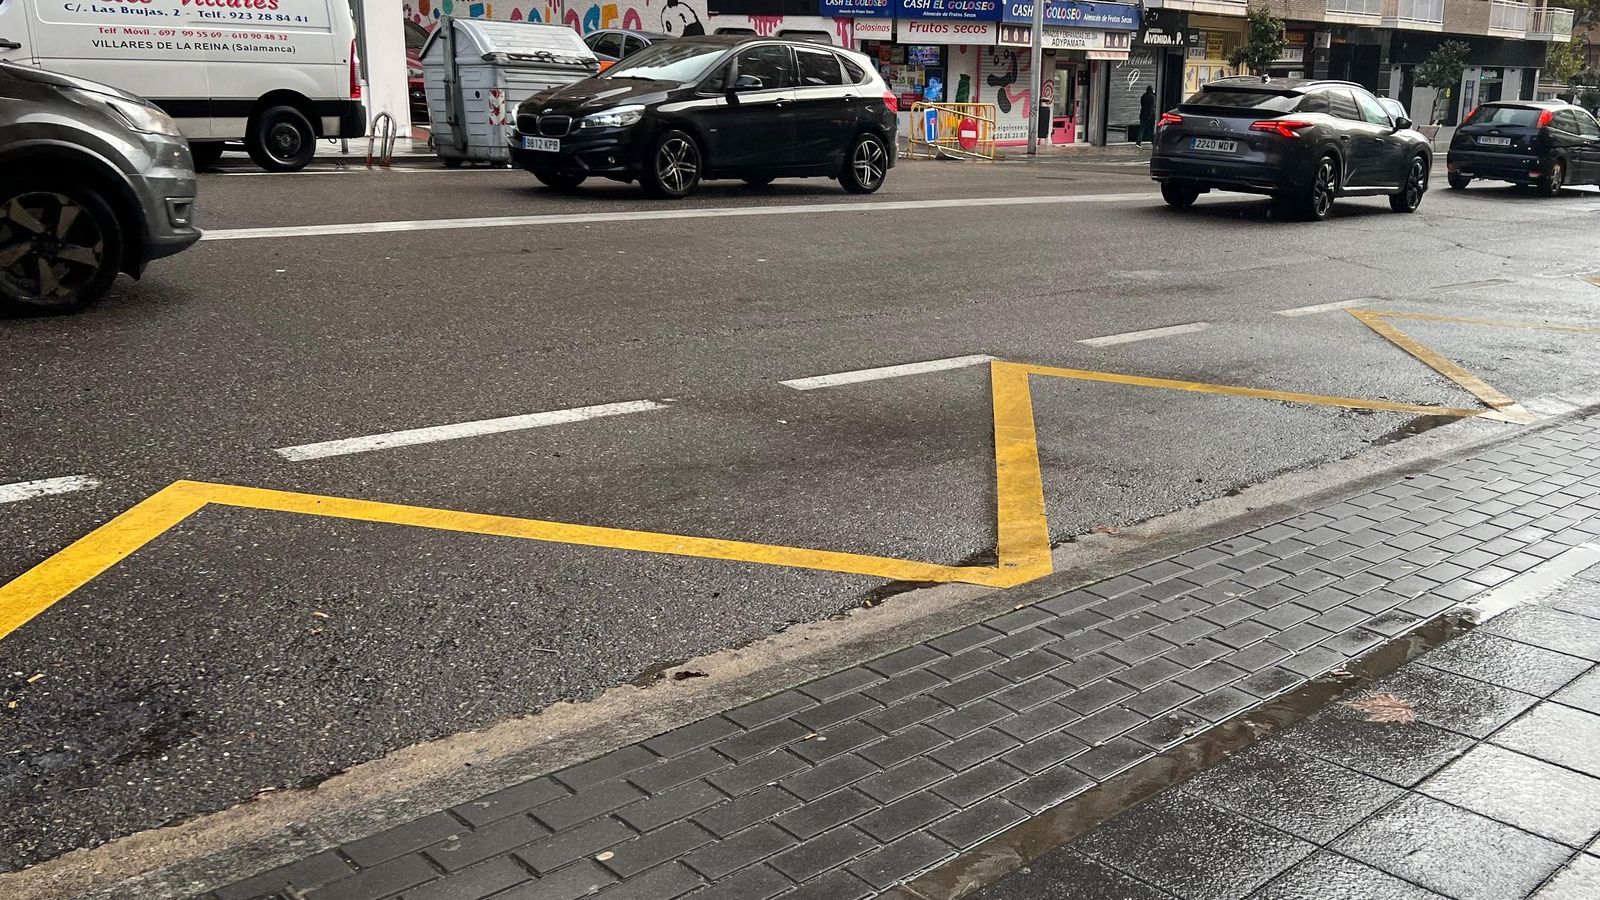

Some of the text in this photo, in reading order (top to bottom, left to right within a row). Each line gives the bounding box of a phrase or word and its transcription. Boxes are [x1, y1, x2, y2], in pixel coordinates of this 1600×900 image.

[903, 0, 995, 11] CASH EL GOLOSEO
[92, 5, 116, 13] Las
[230, 12, 253, 20] 923
[258, 13, 272, 21] 28
[276, 14, 290, 22] 84
[1012, 4, 1081, 19] CASH GOLOSEO
[159, 29, 176, 37] 697
[855, 22, 890, 33] Golosinas
[908, 21, 988, 34] Frutos secos
[92, 40, 153, 49] VILLARES
[176, 42, 191, 50] LA
[194, 43, 229, 51] REINA
[232, 44, 296, 54] (Salamanca)
[527, 138, 543, 149] 9812
[1196, 140, 1215, 149] 2240
